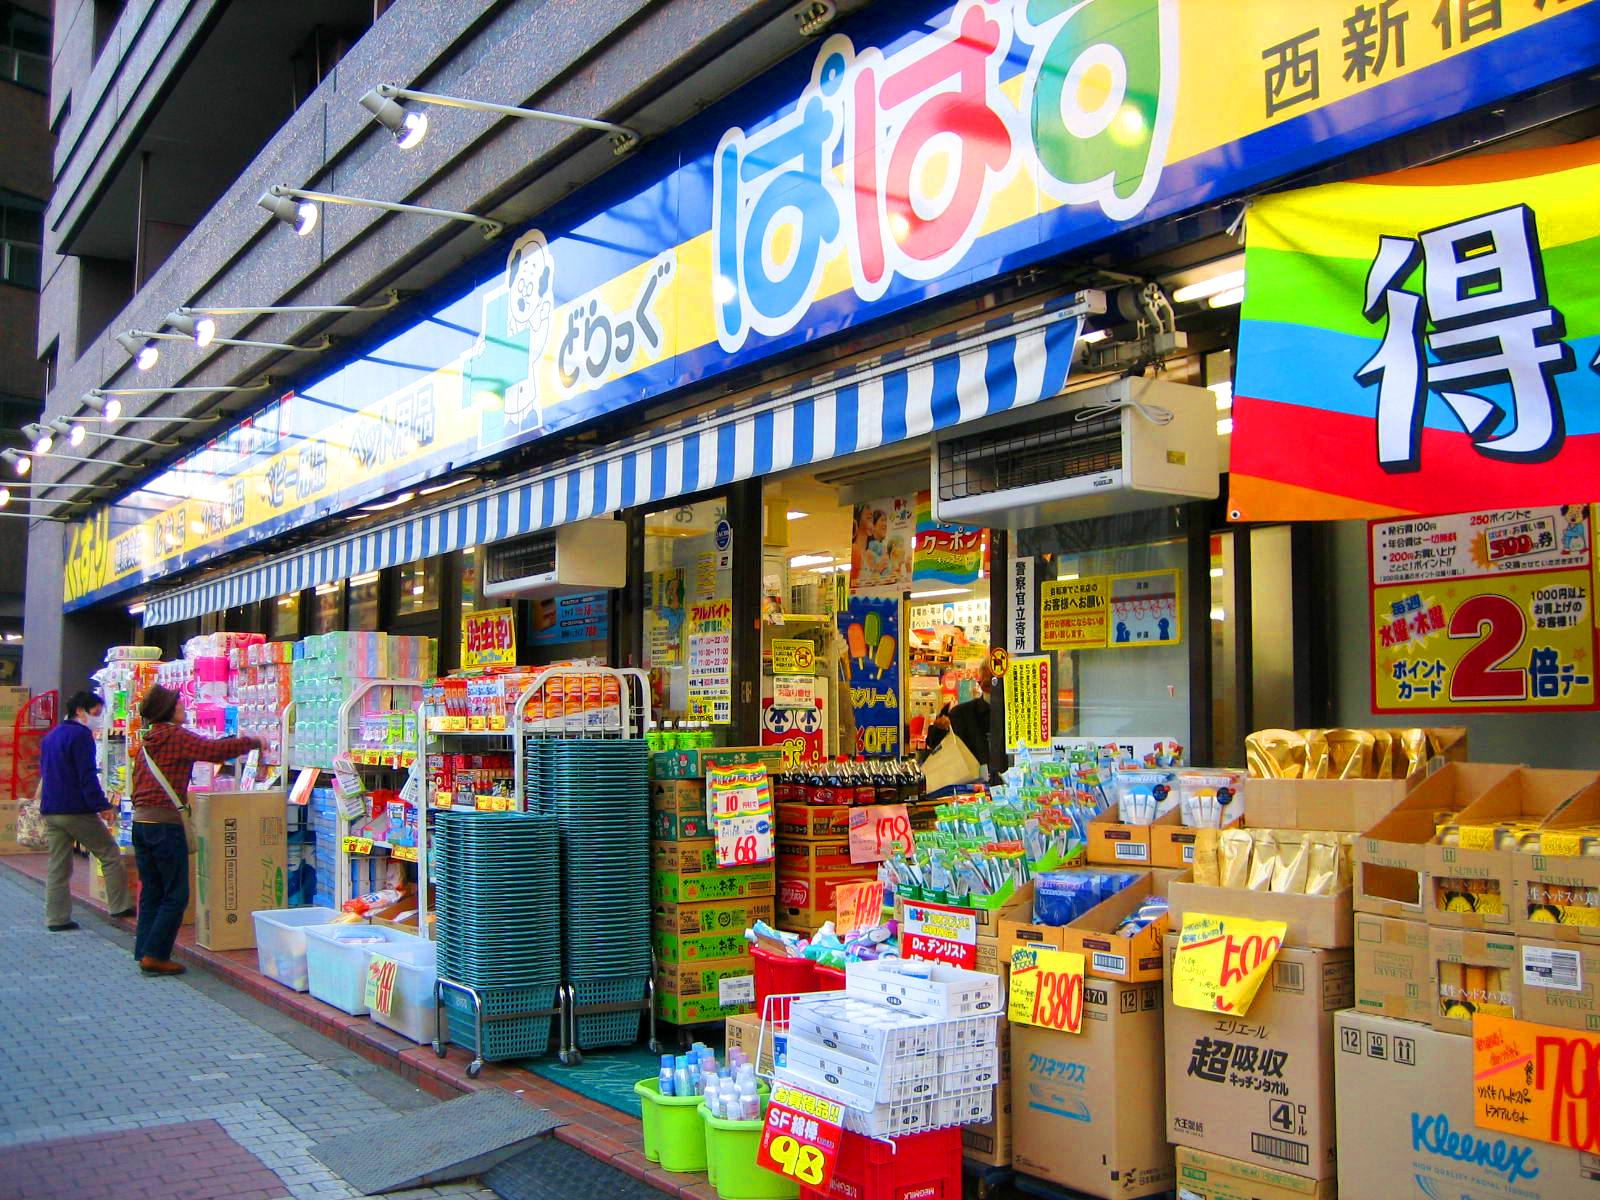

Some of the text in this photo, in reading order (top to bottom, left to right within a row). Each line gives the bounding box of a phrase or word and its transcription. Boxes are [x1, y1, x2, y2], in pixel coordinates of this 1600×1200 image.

[558, 261, 671, 389] どらっぐ
[1353, 203, 1600, 475] 得
[922, 526, 978, 554] クーポン
[1015, 560, 1026, 650] 警察官立寄所
[1043, 595, 1105, 612] お客様へお願い
[1391, 593, 1422, 616] 毎週
[1531, 587, 1586, 602] 1000円以上
[1534, 600, 1582, 616] お買上げの
[1393, 660, 1446, 680] ポイント
[1398, 680, 1443, 699] カード
[725, 794, 739, 813] 10
[875, 815, 912, 856] 178
[734, 835, 757, 864] 68
[1448, 866, 1489, 877] TSUBAKI
[1032, 970, 1084, 1032] 1380
[1085, 989, 1107, 1005] 470
[1123, 992, 1135, 1009] 12
[1215, 1019, 1270, 1039] エリエール
[1343, 1030, 1383, 1048] 12 10
[1028, 1053, 1089, 1084] クリネックス
[1187, 1036, 1289, 1084] 超吸収
[1229, 1072, 1289, 1097] キッチンタオル
[1271, 1103, 1308, 1136] 4 ロール
[1410, 1112, 1540, 1184] Kleenex
[769, 1135, 826, 1185] 98
[1435, 1168, 1469, 1181] QUALITY
[903, 1187, 935, 1200] MEGMILK
